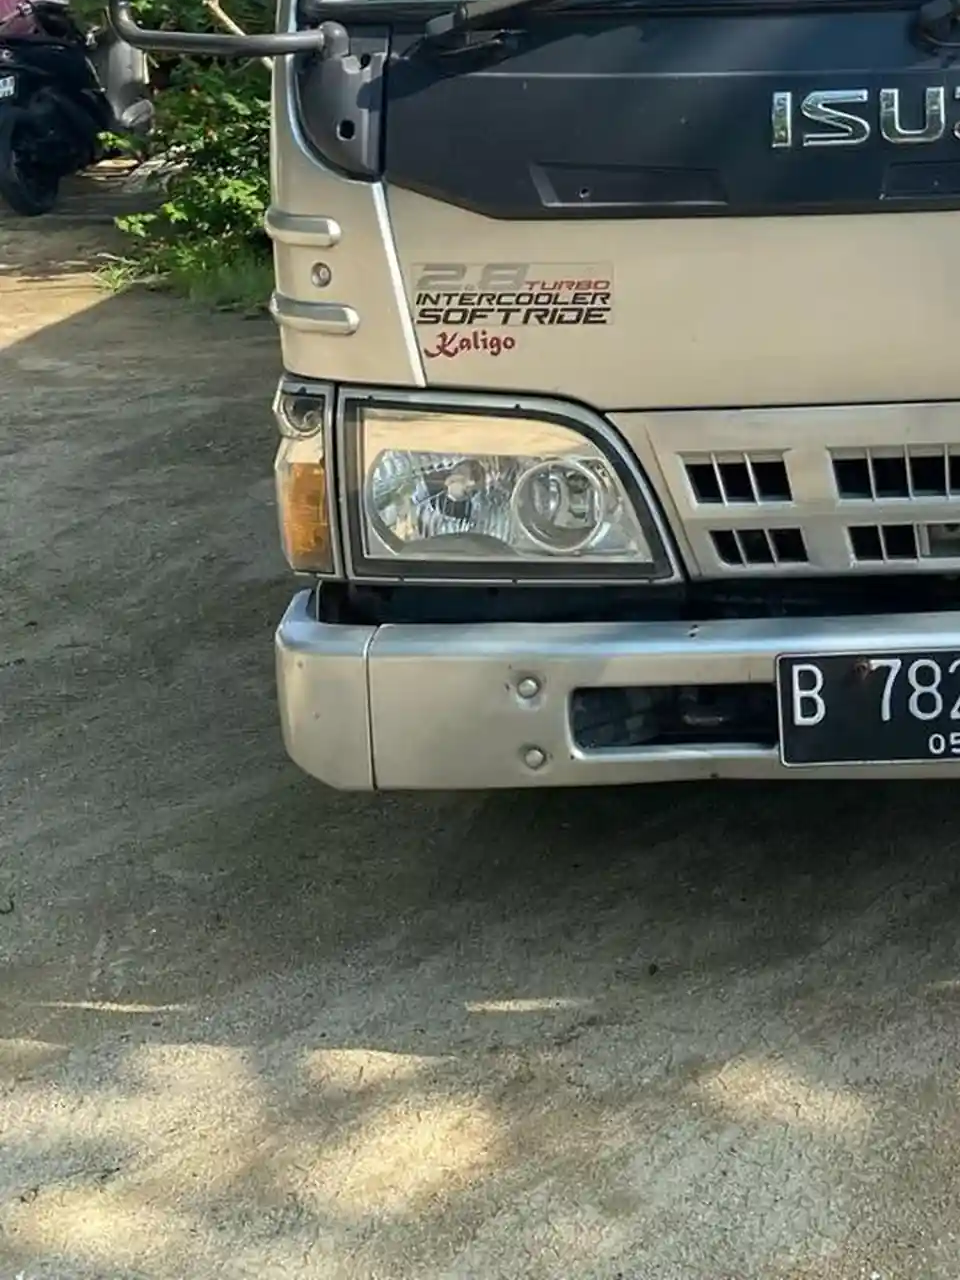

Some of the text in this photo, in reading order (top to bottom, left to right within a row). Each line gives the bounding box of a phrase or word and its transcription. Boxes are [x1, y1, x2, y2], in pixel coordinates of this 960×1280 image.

[524, 280, 611, 291] TURBO
[415, 292, 612, 306] INTERCOOLER
[424, 329, 517, 358] Kaligo
[791, 663, 826, 726] B
